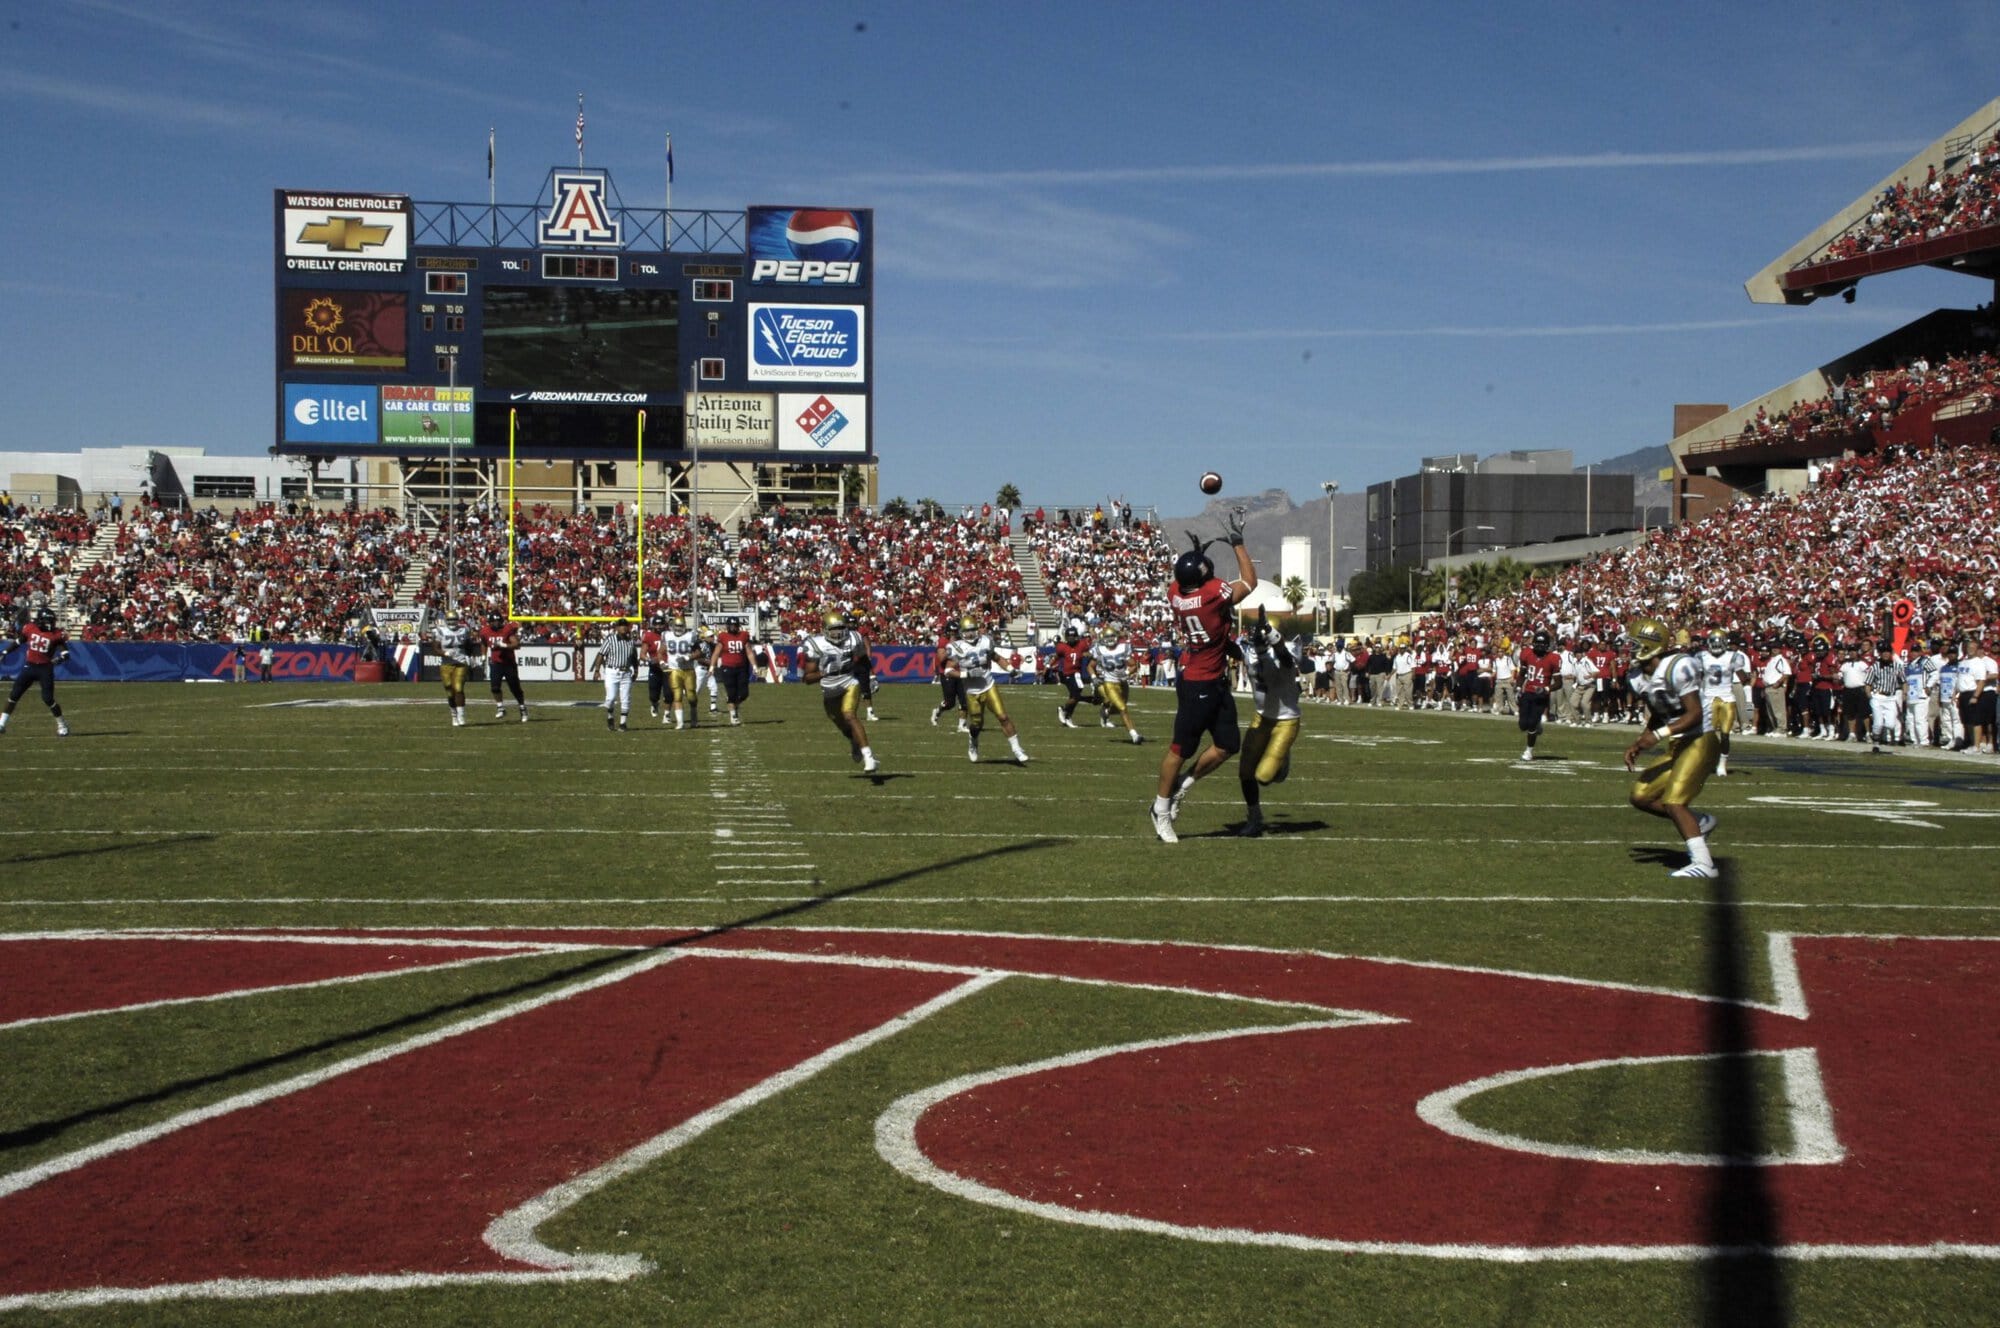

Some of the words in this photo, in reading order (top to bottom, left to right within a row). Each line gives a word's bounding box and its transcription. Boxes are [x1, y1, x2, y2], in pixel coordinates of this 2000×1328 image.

[287, 196, 334, 208] WATSON
[337, 198, 402, 210] CHEVROLET
[287, 258, 336, 270] O'RIELLY
[338, 261, 403, 272] CHEVROLET
[502, 261, 520, 270] TOL
[641, 265, 658, 274] TOL
[752, 260, 860, 283] PEPSI
[780, 315, 834, 330] Tucson
[292, 335, 320, 352] DEL
[327, 336, 355, 353] SOL
[785, 330, 848, 344] Electric
[435, 345, 448, 354] BALL
[450, 346, 459, 354] ON
[792, 344, 848, 358] Power
[760, 369, 796, 377] UniSource
[798, 370, 822, 378] Energy
[824, 370, 858, 379] Company
[383, 385, 436, 401] BRAKE
[528, 391, 648, 402] ARIZONAATHLETICS.COM
[384, 402, 404, 412] CAR
[406, 402, 430, 412] CARE
[697, 395, 762, 412] Arizona
[295, 399, 368, 424] alltel
[736, 414, 772, 430] Star
[812, 410, 841, 440] Domino's
[712, 436, 743, 446] Tucson
[746, 436, 770, 446] thing
[818, 429, 836, 447] Pizza
[30, 633, 51, 653] 23
[668, 640, 688, 654] 90
[525, 656, 548, 667] MILK
[1070, 652, 1077, 665] 7
[1527, 666, 1544, 684] 84
